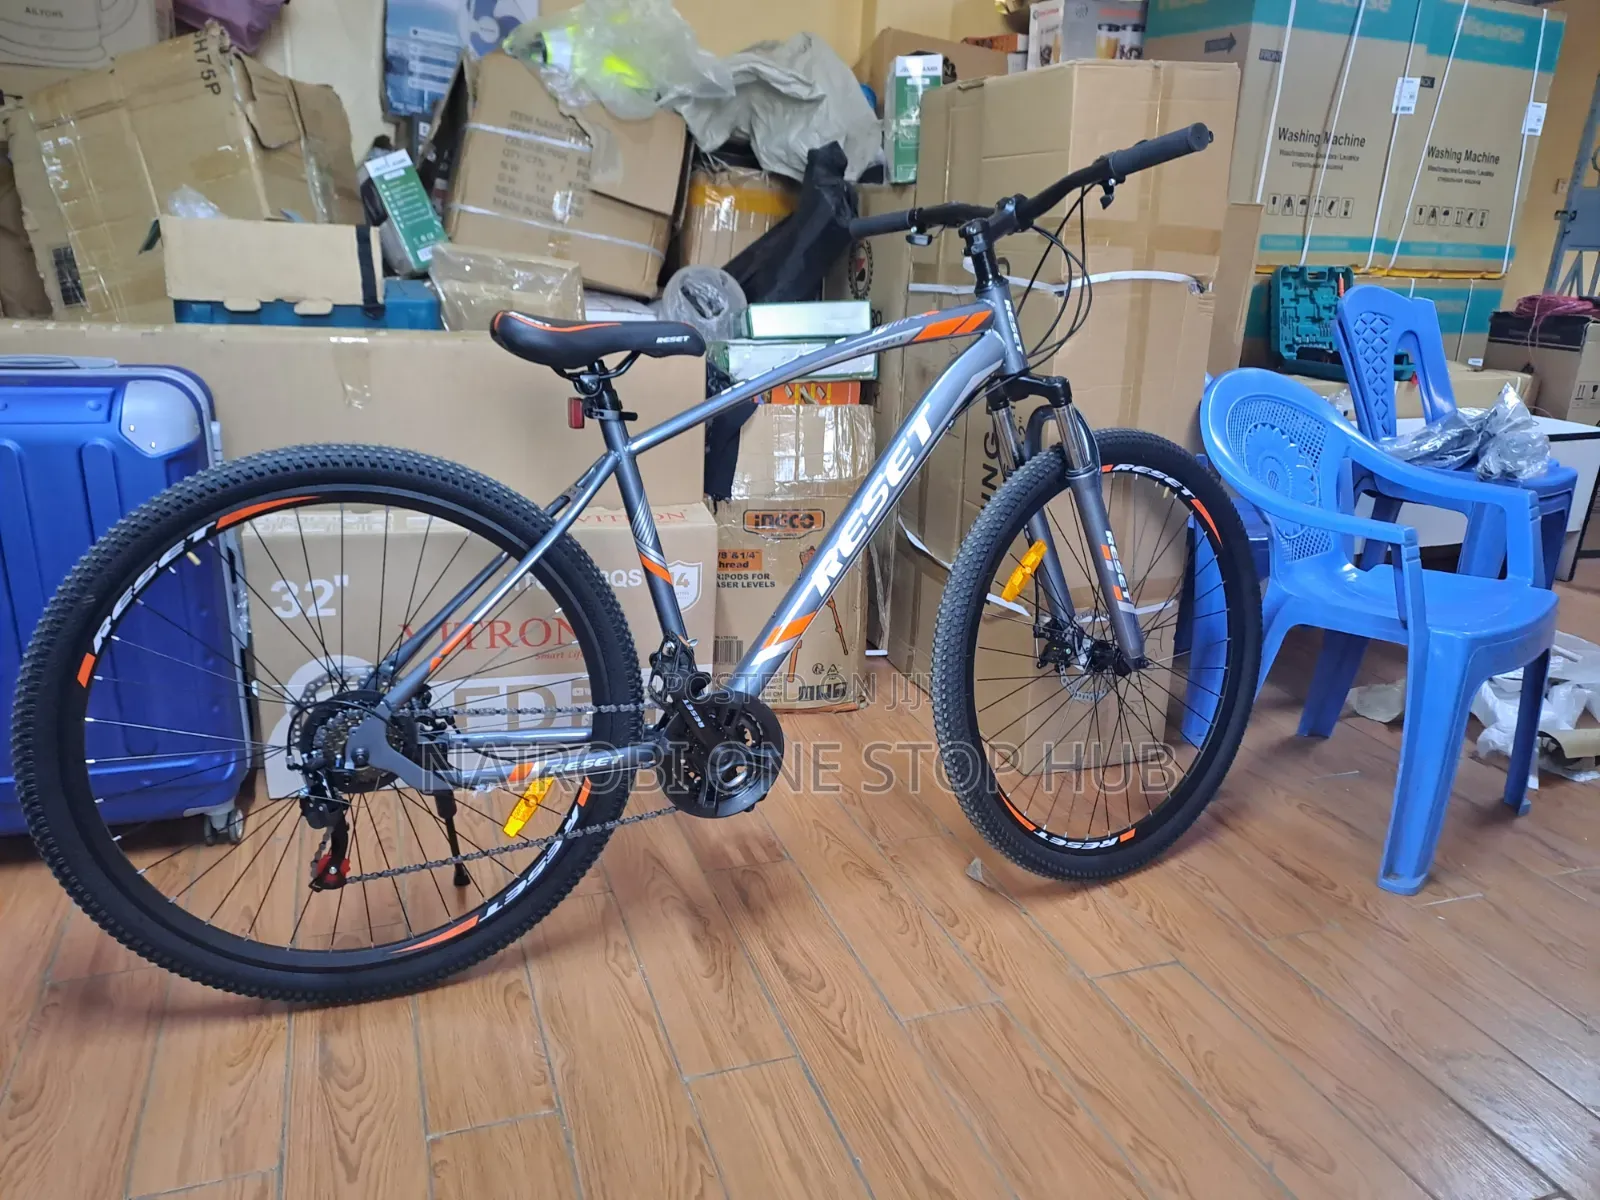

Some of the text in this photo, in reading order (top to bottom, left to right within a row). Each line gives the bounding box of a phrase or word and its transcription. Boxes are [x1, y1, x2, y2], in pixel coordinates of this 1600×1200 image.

[1278, 127, 1366, 148] Washing Machine
[1427, 145, 1500, 165] Washing Machine
[656, 335, 690, 344] RESET
[1004, 299, 1024, 355] RESET
[1112, 463, 1196, 498] RESET
[810, 402, 932, 597] RESET
[577, 511, 686, 524] VITON
[1105, 530, 1131, 601] RESET
[93, 521, 217, 655] RESET
[271, 574, 349, 619] 32"
[682, 699, 705, 728] RESET
[548, 753, 624, 775] RESET
[1033, 830, 1119, 850] RESET
[479, 805, 579, 922] RESET
